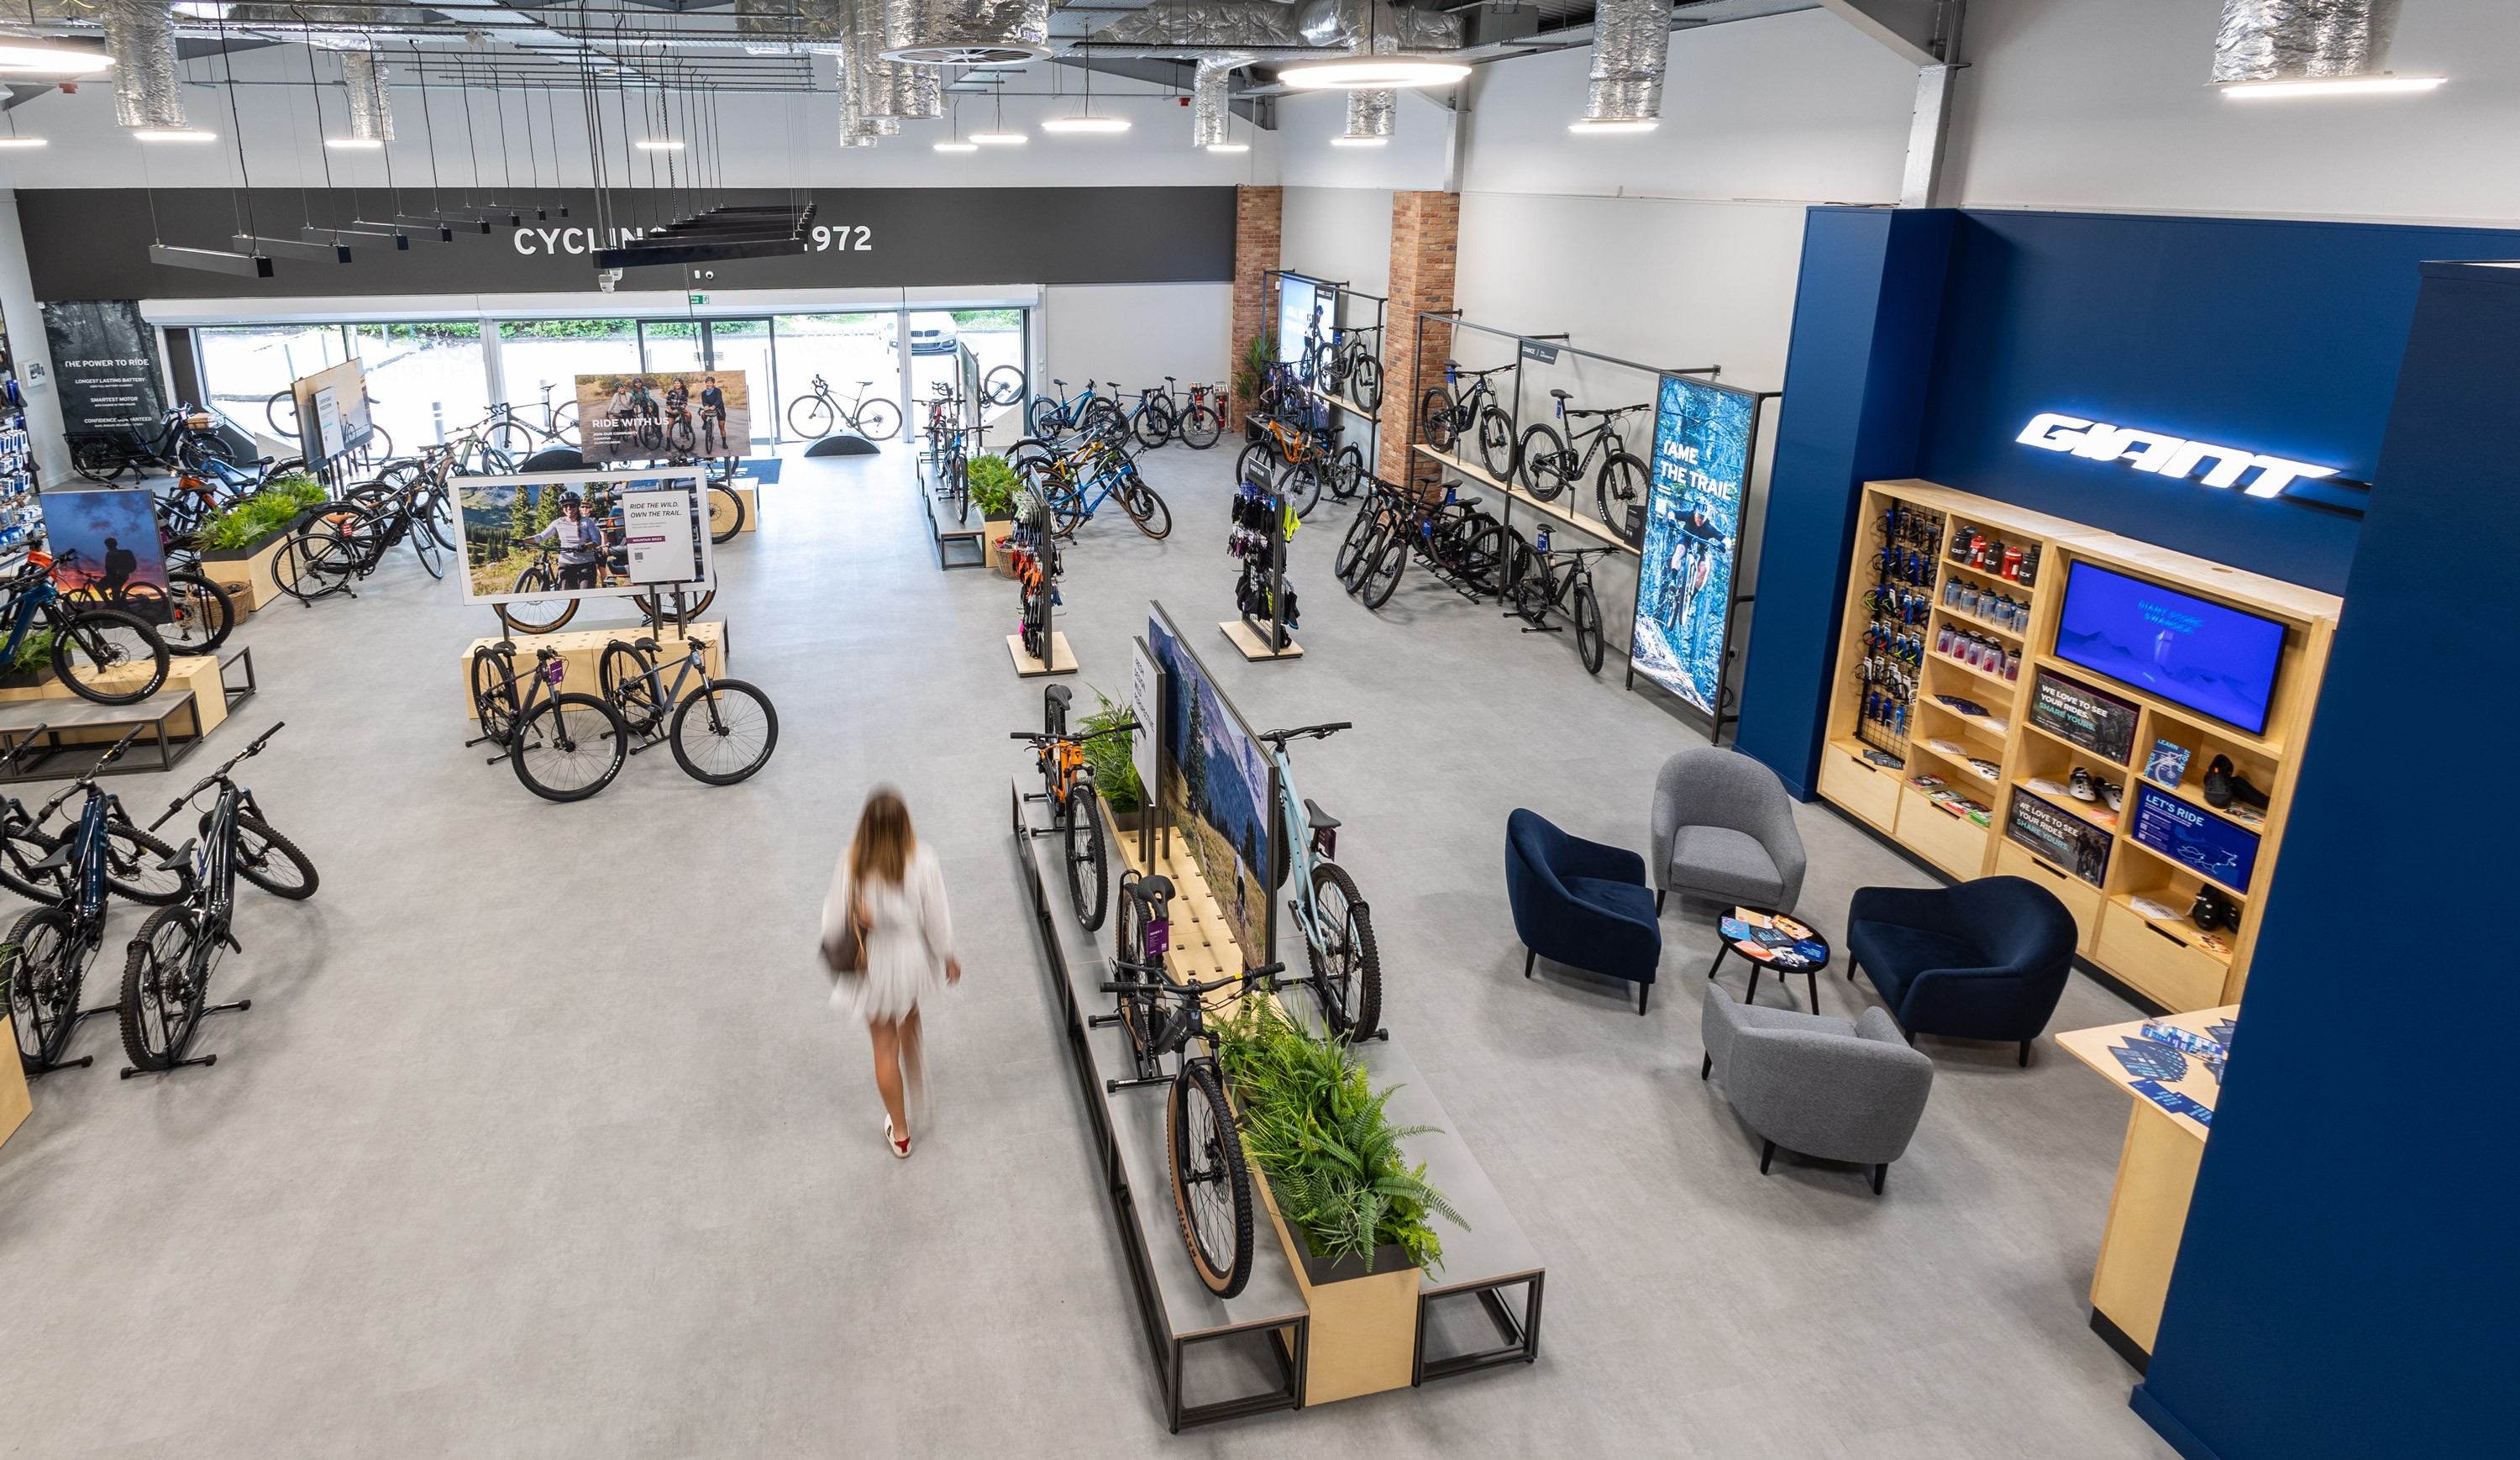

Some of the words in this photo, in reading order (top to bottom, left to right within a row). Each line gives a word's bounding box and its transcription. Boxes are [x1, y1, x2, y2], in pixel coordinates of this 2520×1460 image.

[514, 228, 667, 255] CYCLIN
[804, 226, 872, 252] 972
[592, 418, 619, 428] RIDE
[622, 418, 652, 427] WITH
[654, 418, 669, 426] US
[1663, 439, 1698, 465] TAME
[2015, 413, 2342, 498] GIANT
[1660, 461, 1688, 484] THE
[1689, 471, 1731, 501] TRAIL
[2040, 693, 2064, 708] YOUR
[2063, 703, 2089, 720] RIDES.
[2042, 685, 2056, 696] WE
[2056, 691, 2078, 705] LOVE
[2079, 700, 2091, 710] TO
[2092, 706, 2108, 717] SEE
[2039, 702, 2066, 718] SHARE
[2066, 713, 2096, 732] YOURS.
[2157, 739, 2179, 750] LEARN
[2019, 802, 2031, 811] WE
[2031, 806, 2051, 822] LOVE
[2052, 817, 2063, 827] TO
[2063, 824, 2079, 837] SEE
[2019, 810, 2040, 826] YOUR
[2040, 821, 2065, 839] RIDES.
[2145, 794, 2175, 813] LET'S
[2176, 807, 2205, 827] RIDE
[2016, 818, 2042, 837] SHARE
[2042, 832, 2070, 852] YOURS.
